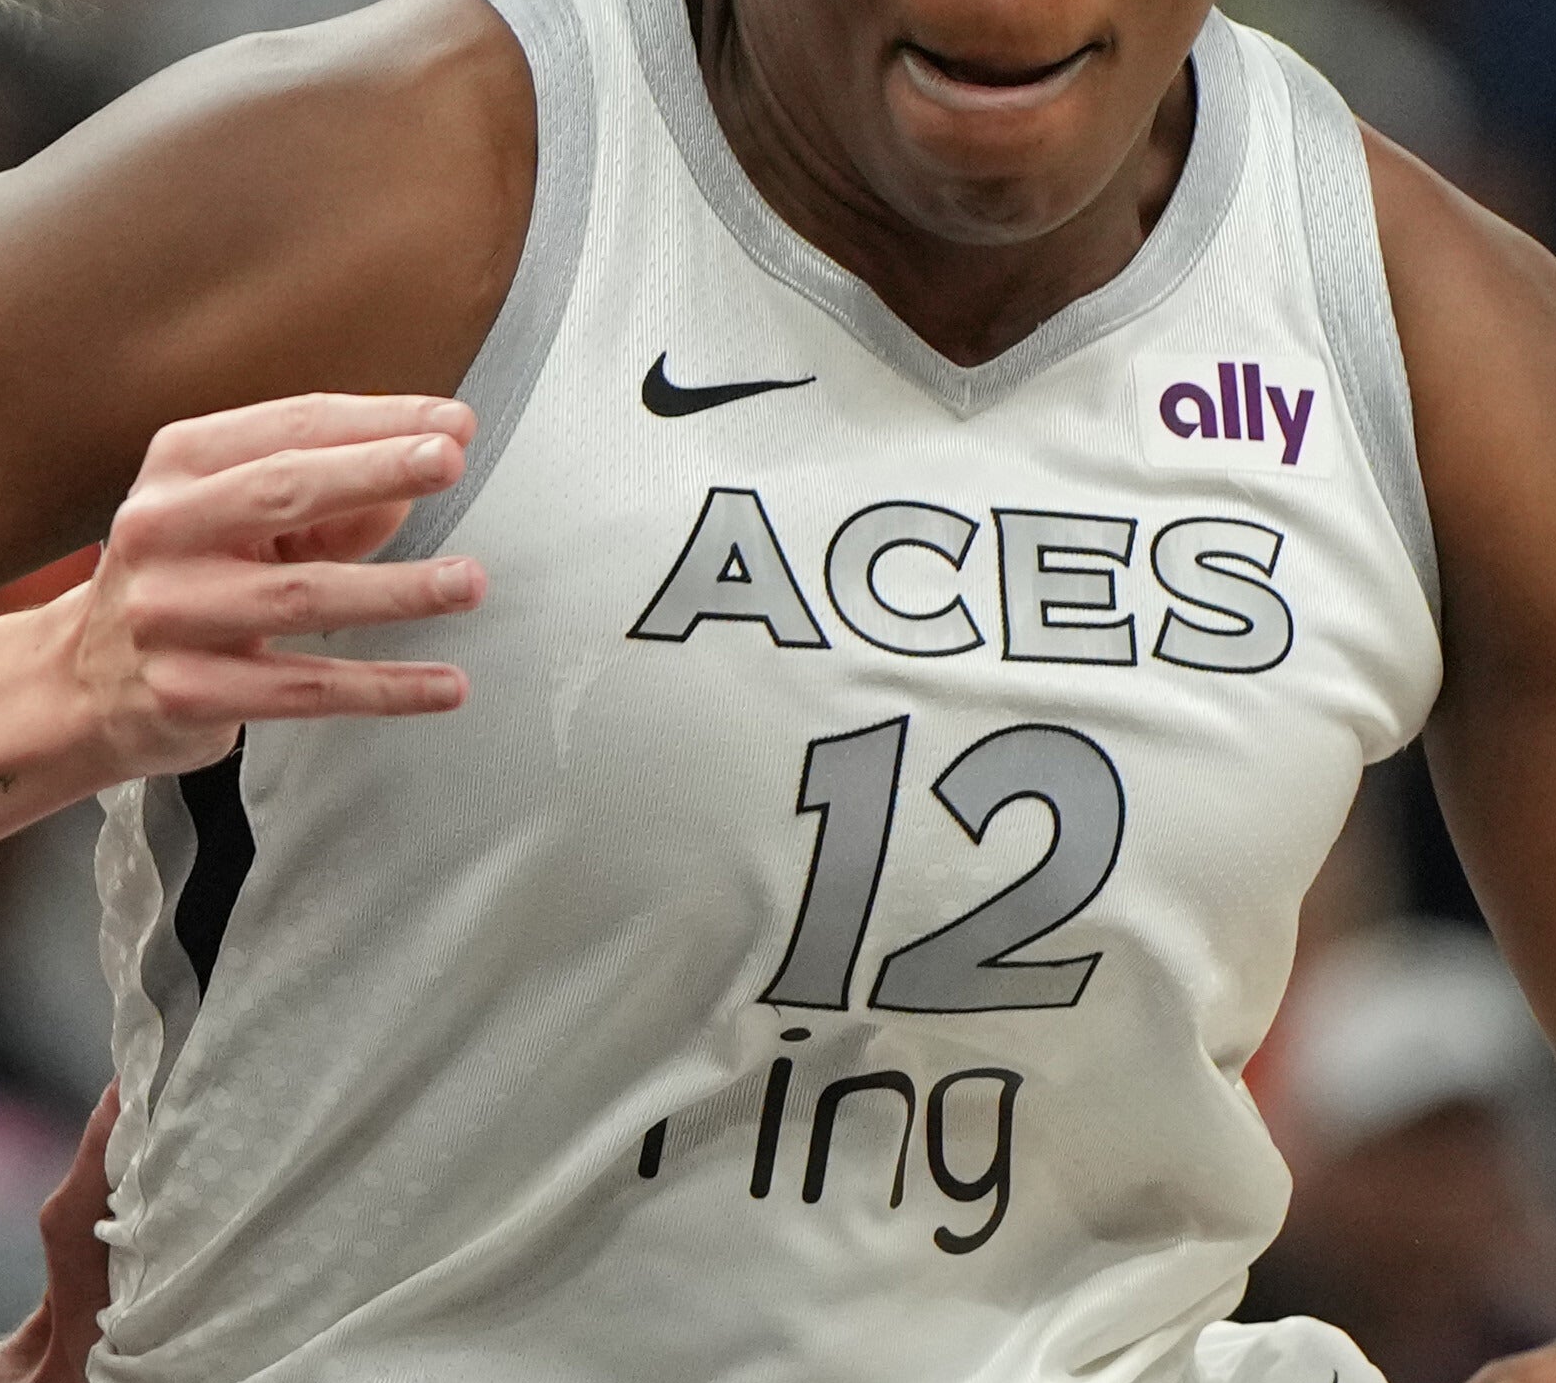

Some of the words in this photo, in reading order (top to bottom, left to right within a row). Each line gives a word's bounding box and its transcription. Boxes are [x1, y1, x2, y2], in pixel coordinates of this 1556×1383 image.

[1159, 362, 1315, 465] ally
[626, 487, 1294, 673] ACES
[758, 714, 1126, 1012] 12
